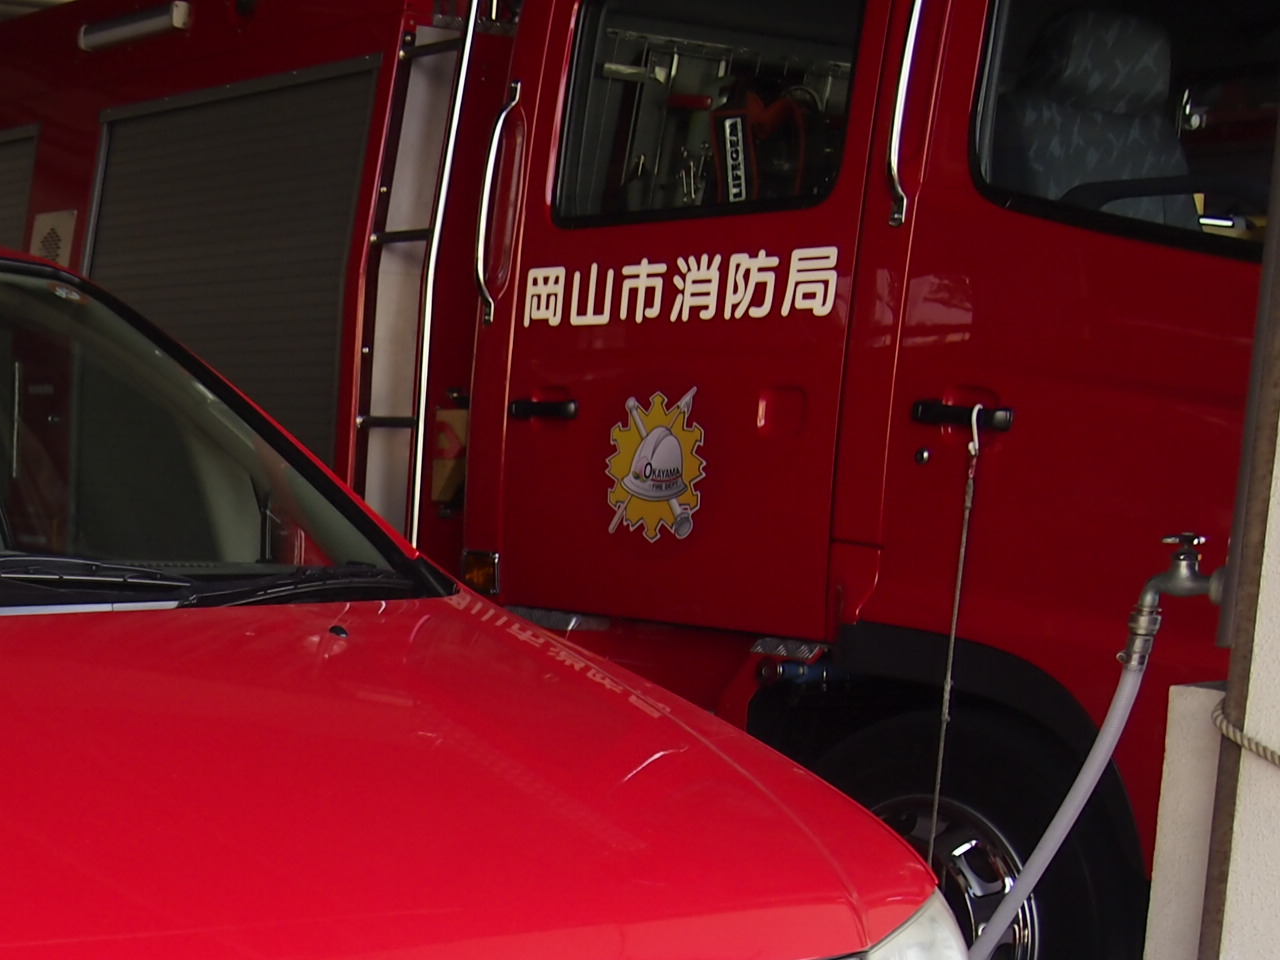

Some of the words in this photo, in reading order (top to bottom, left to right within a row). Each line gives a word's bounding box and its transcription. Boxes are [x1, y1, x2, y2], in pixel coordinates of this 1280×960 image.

[523, 246, 838, 328] 岡山市消防局
[643, 461, 681, 480] OKAYAMA
